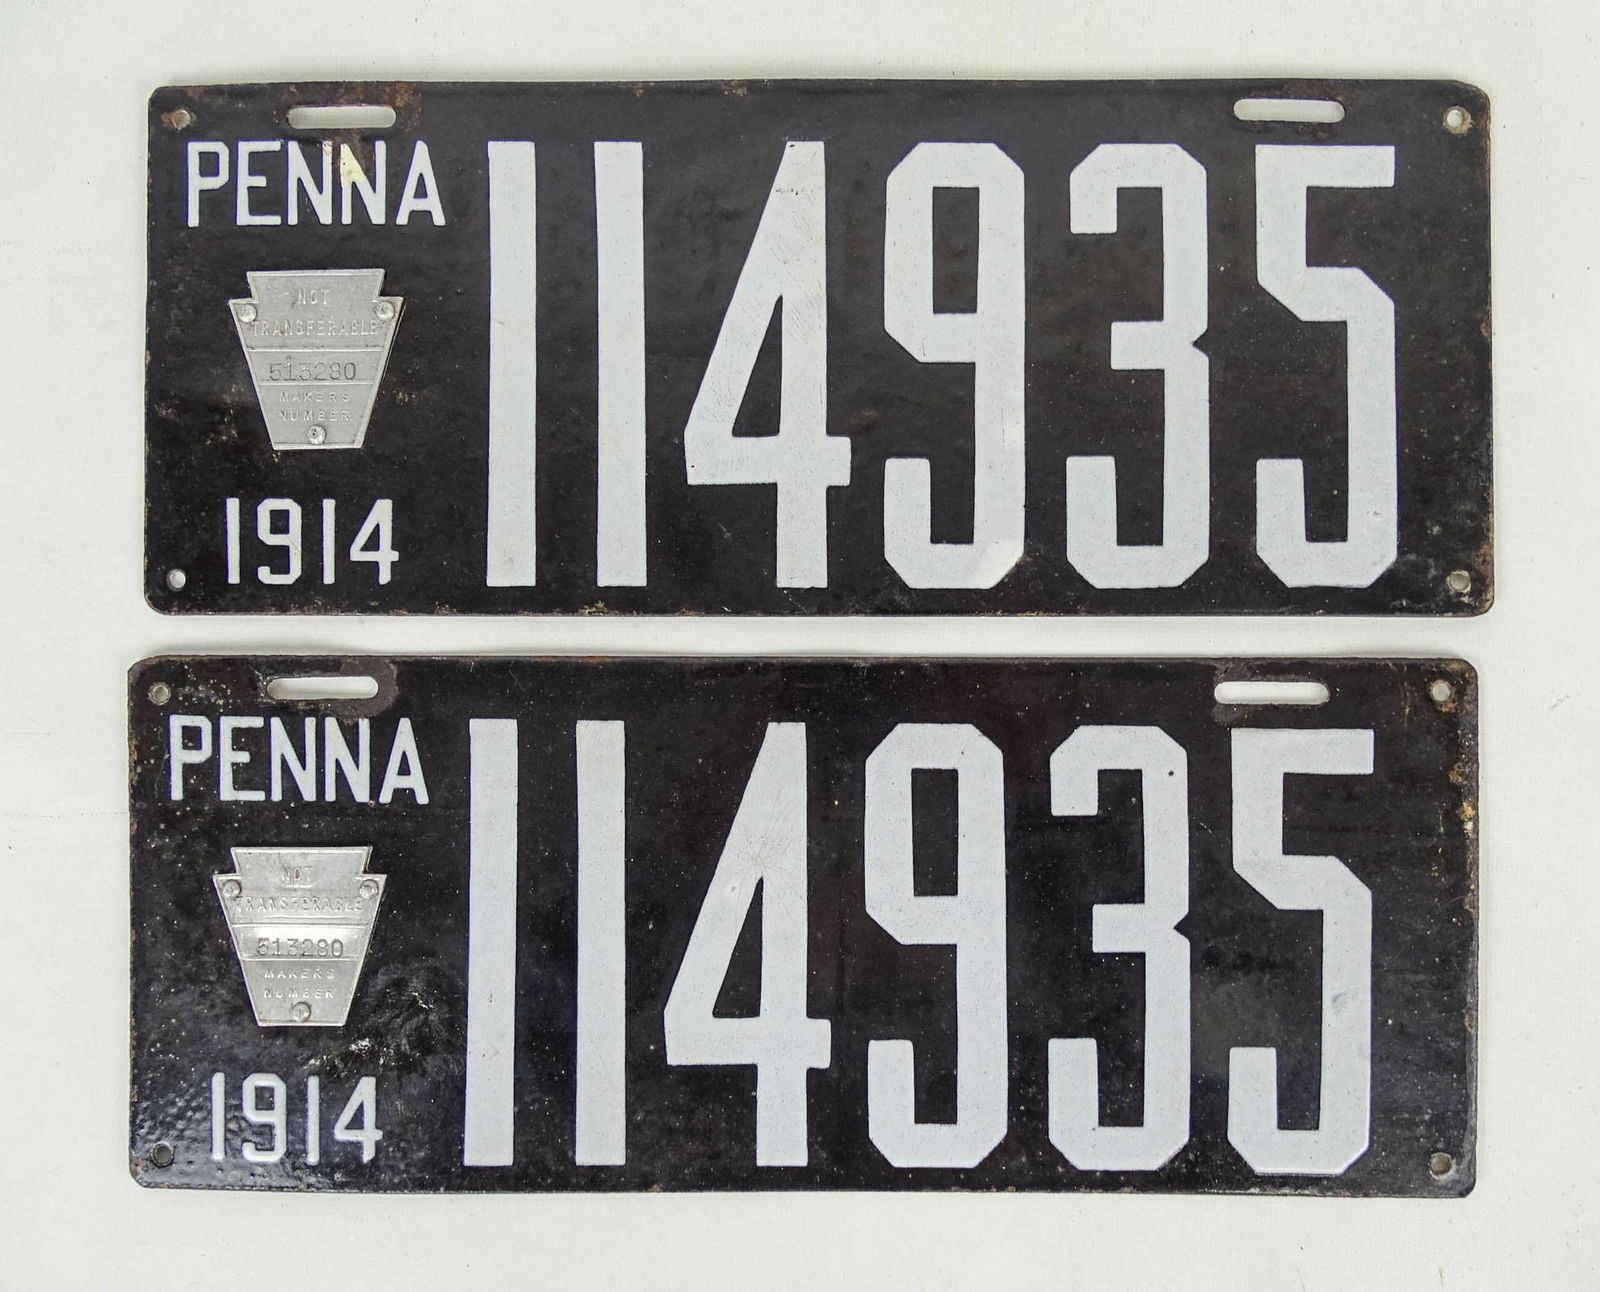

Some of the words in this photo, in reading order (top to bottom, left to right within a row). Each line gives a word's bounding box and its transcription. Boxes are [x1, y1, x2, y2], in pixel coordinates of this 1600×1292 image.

[188, 141, 445, 227] PENNA
[296, 288, 329, 305] NOT
[252, 320, 378, 337] TRANSFERABLE
[269, 361, 356, 382] 513280
[487, 141, 1398, 589] 114935
[279, 391, 351, 402] MAKERS
[279, 410, 351, 422] NUMBER
[227, 498, 399, 584] 1914
[170, 715, 429, 804] PENNA
[281, 865, 314, 882] NOT
[236, 895, 363, 912] TRANSFERABLE
[256, 937, 343, 958] 513280
[464, 719, 1374, 1177] 114935
[264, 969, 336, 979] MAKERS
[263, 988, 336, 999] NUMBER
[210, 1073, 383, 1166] 1914
